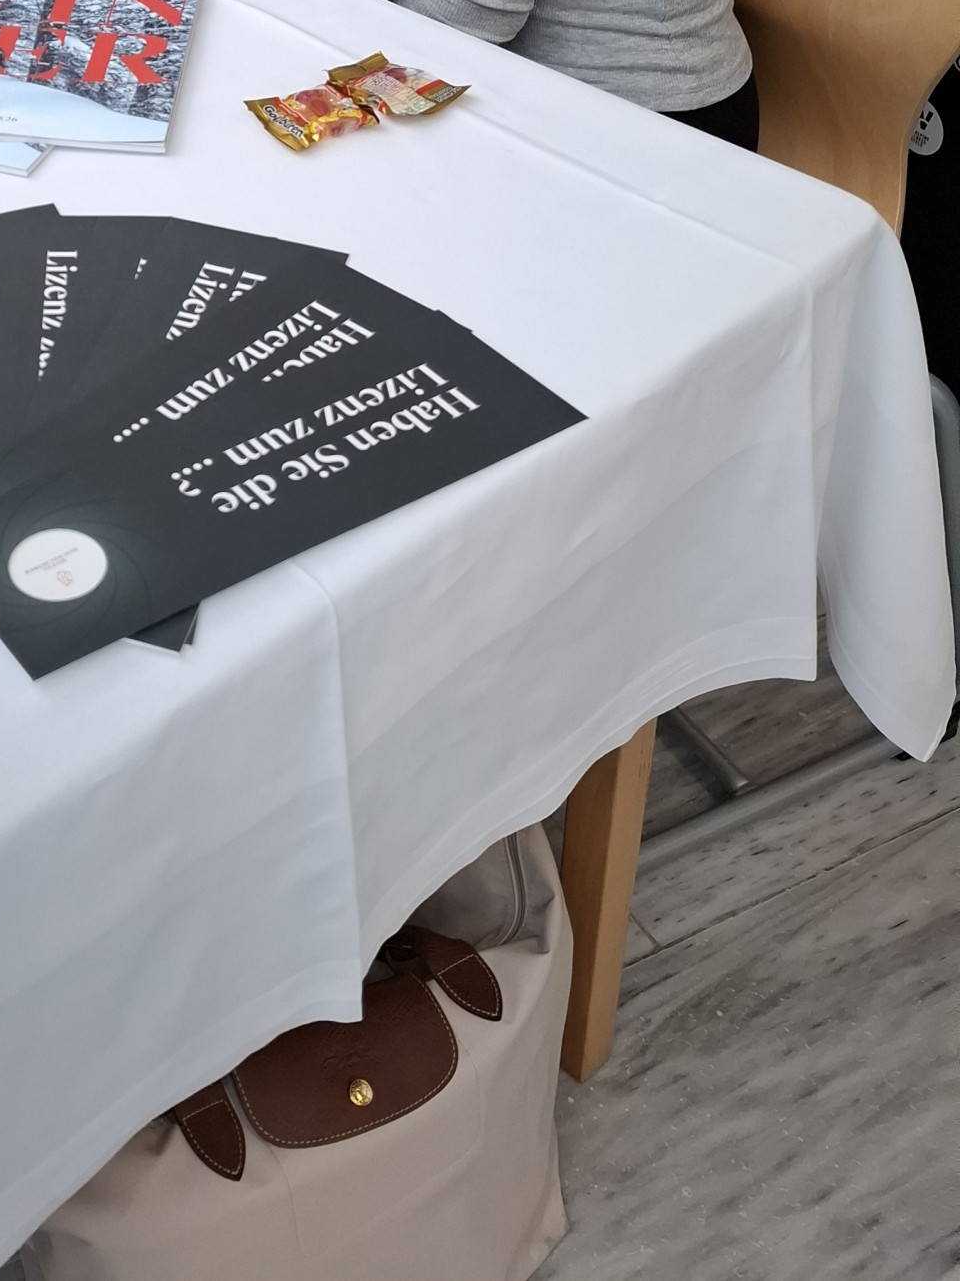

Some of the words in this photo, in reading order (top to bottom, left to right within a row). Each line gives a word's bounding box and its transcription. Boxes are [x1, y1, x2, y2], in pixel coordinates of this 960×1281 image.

[42, 250, 78, 330] Lizenz
[228, 301, 340, 371] Lizenz
[156, 368, 234, 420] zum
[314, 364, 448, 426] Lizenz
[344, 387, 480, 450] Haben
[224, 418, 314, 465] zum
[281, 444, 349, 480] Sie
[212, 474, 277, 512] die
